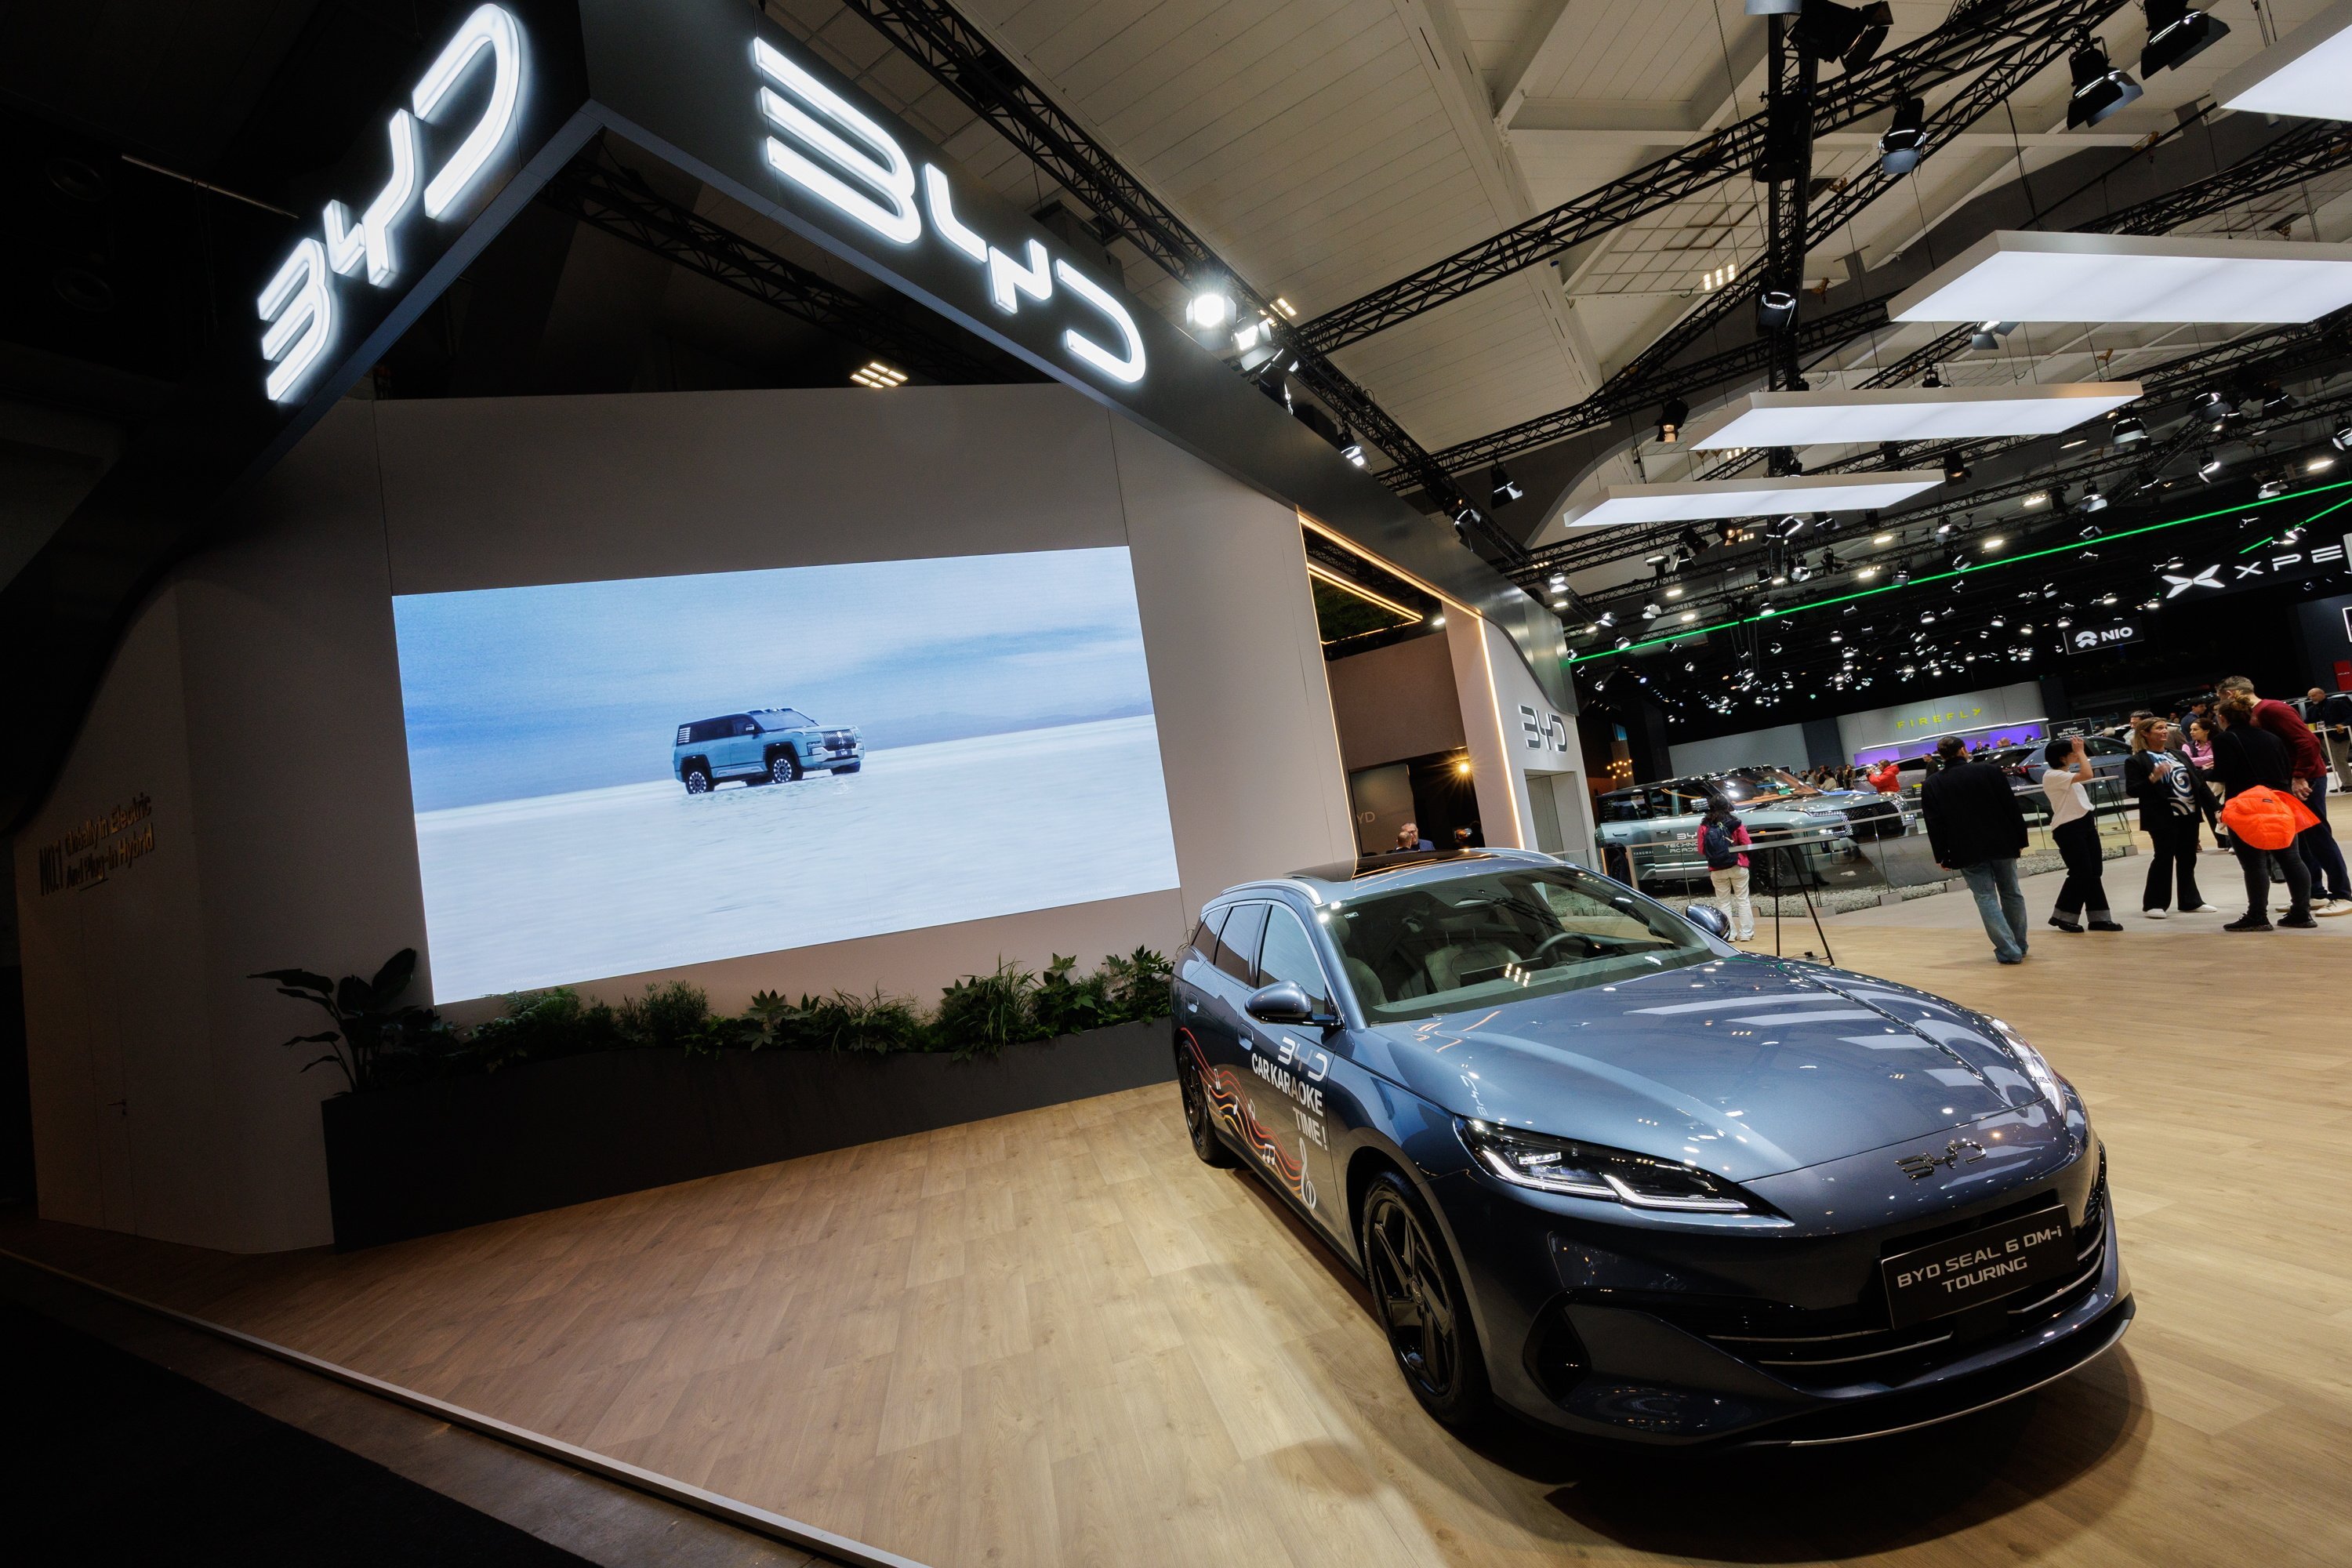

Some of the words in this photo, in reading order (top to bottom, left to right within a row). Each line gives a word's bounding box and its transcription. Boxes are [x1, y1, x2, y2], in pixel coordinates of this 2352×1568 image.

[258, 2, 521, 401] BYD
[753, 36, 1147, 384] BYD
[2101, 626, 2133, 642] NIO
[1518, 704, 1567, 753] BYD
[1896, 708, 1982, 729] FIREFLY
[100, 815, 110, 840] in
[110, 792, 152, 835] Electric
[1356, 811, 1376, 824] YD
[1676, 832, 1698, 840] BY
[66, 856, 84, 889] And
[118, 822, 154, 869] Hybrid
[1277, 1036, 1328, 1082] BYD
[1251, 1052, 1271, 1083] CAR
[1271, 1063, 1324, 1117] KARAOKE
[1894, 1139, 1987, 1180] BYD
[1896, 1263, 1940, 1288] BYD
[1944, 1247, 2002, 1272] SEAL
[2005, 1239, 2020, 1253] 6
[2023, 1225, 2063, 1247] DM-i
[1941, 1256, 2028, 1293] TOURING
